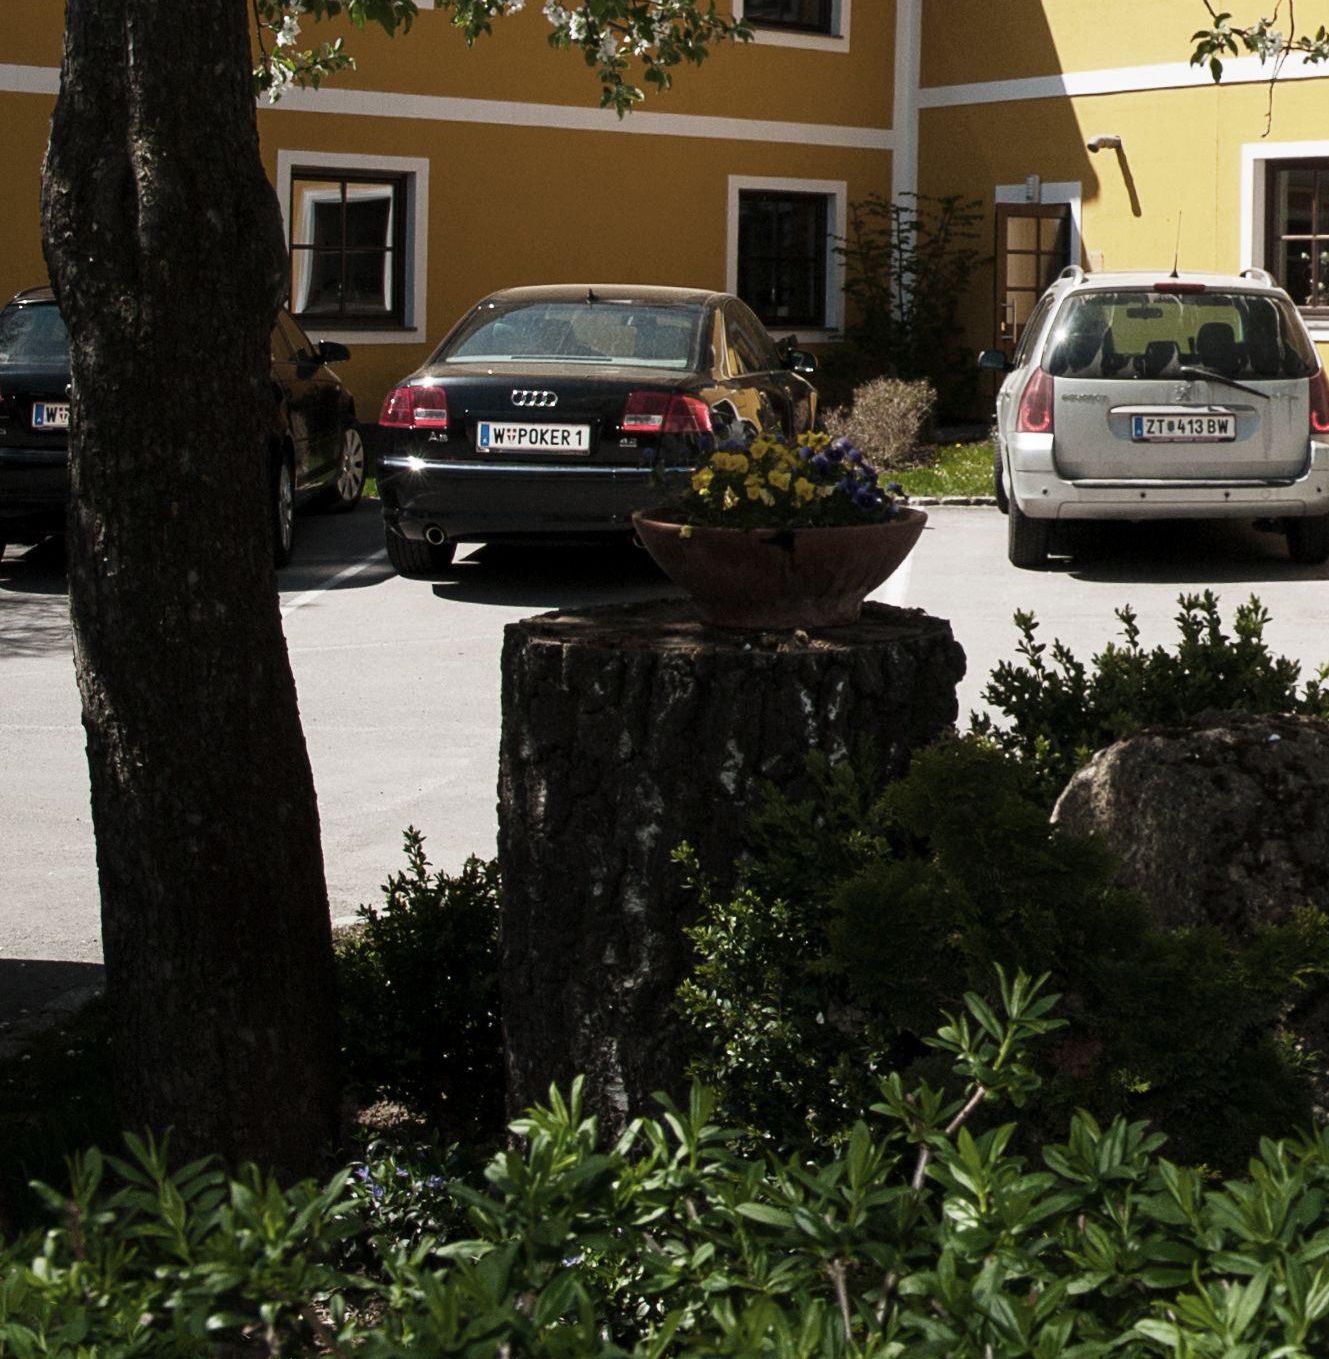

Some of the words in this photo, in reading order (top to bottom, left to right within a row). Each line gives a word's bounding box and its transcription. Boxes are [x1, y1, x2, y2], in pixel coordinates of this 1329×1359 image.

[46, 406, 57, 423] W
[1146, 419, 1166, 434] ZT
[1177, 419, 1204, 434] 413
[1208, 419, 1230, 434] BW
[493, 427, 506, 444] W
[518, 428, 570, 446] POKER
[576, 430, 583, 446] 1
